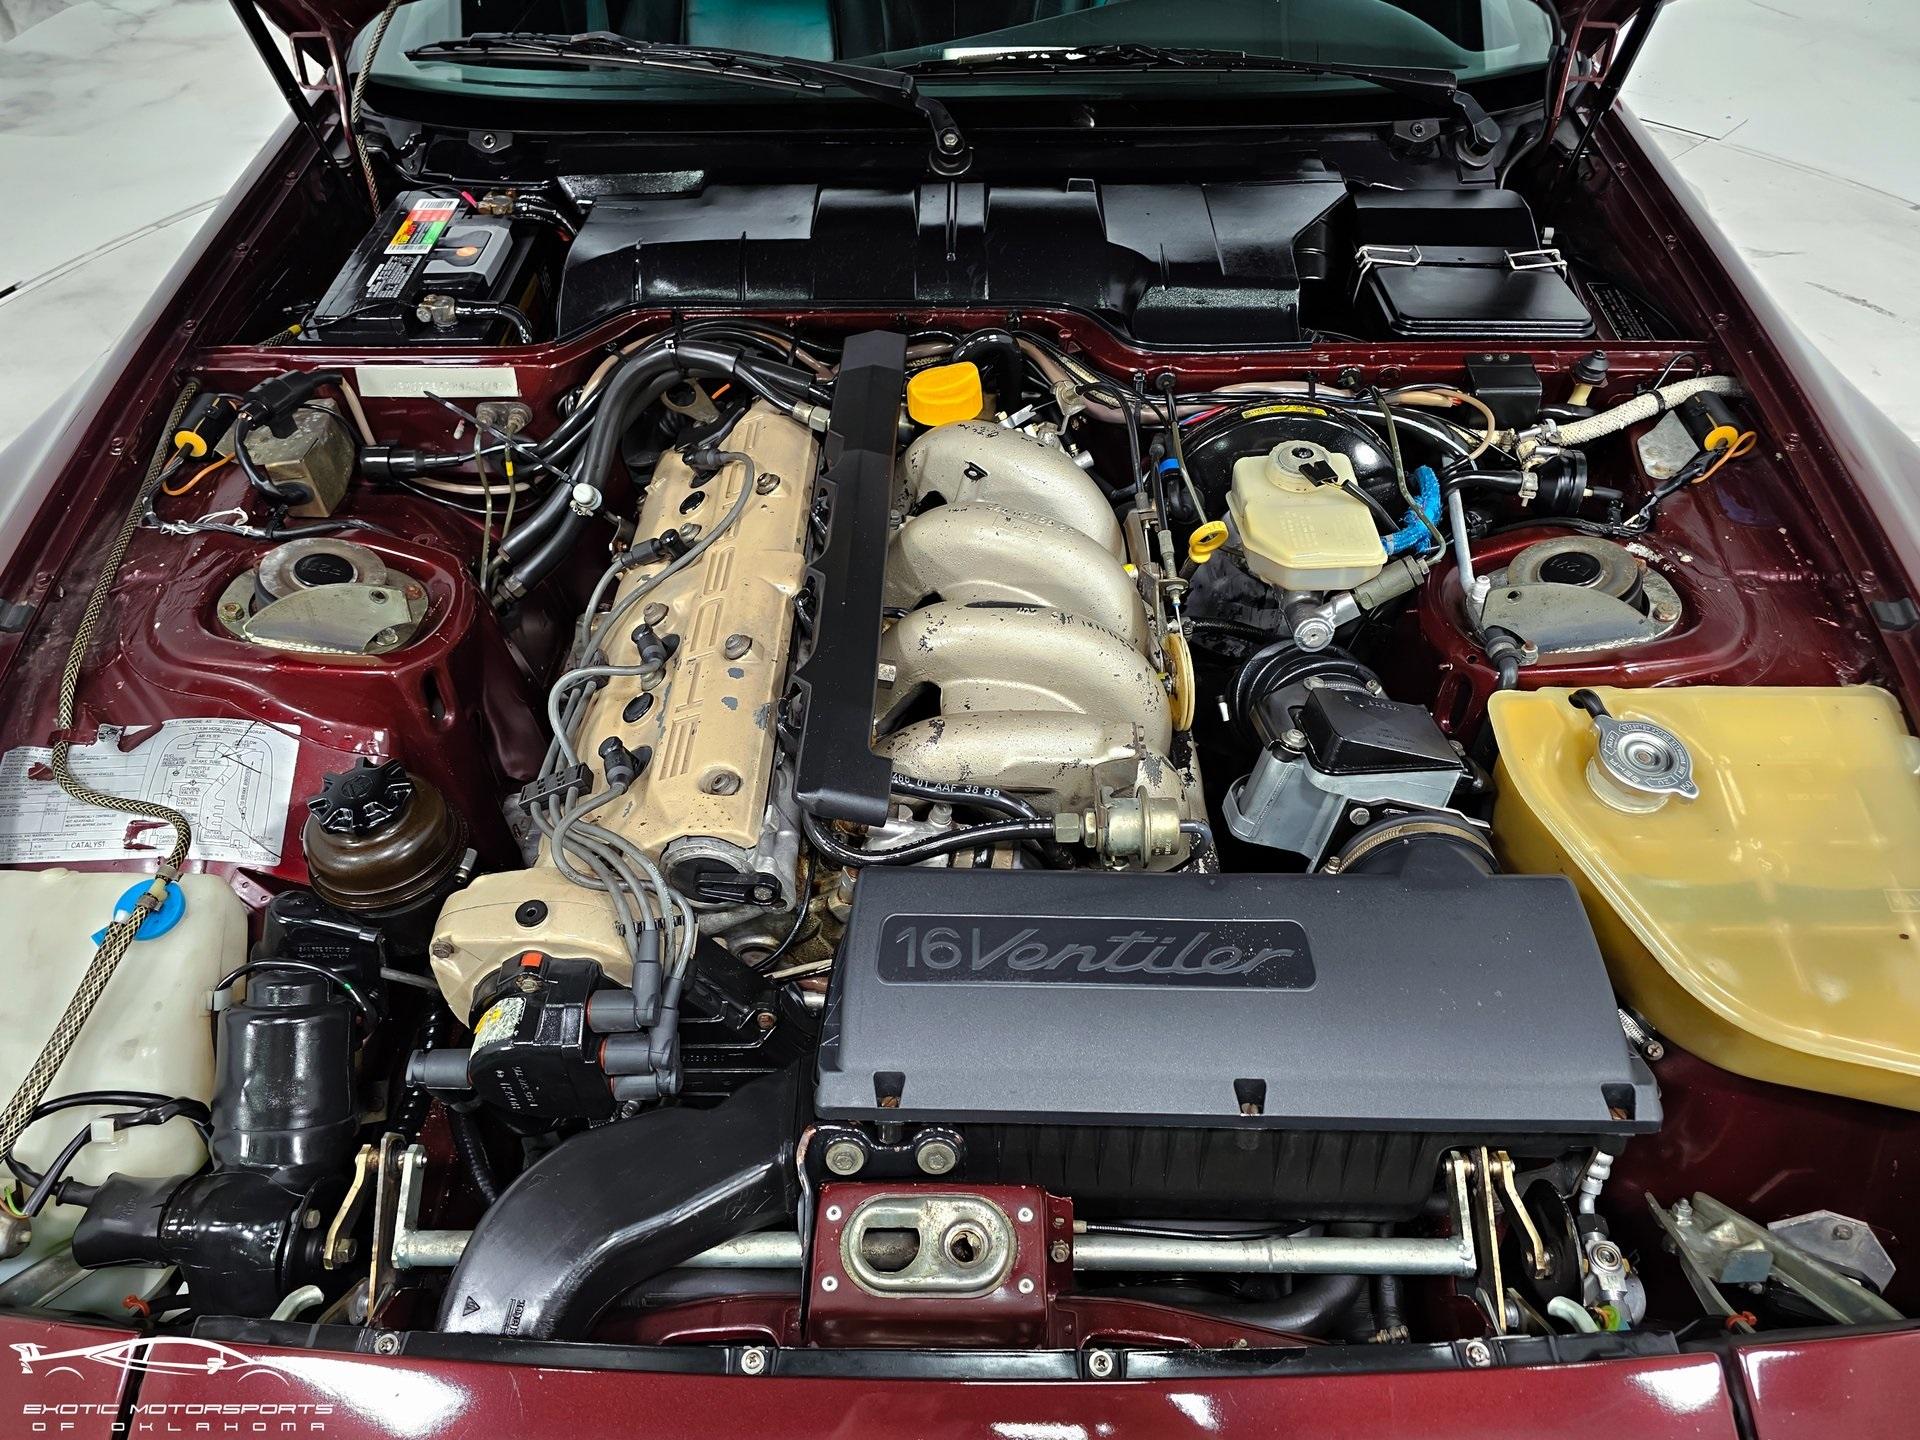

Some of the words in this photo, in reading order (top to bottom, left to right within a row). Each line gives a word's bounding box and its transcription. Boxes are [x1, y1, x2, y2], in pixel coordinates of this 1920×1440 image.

[1609, 758, 1641, 783] BEHR
[934, 782, 959, 793] AAF
[964, 784, 979, 794] 38
[984, 788, 1000, 798] 89
[70, 841, 106, 849] CATALYST
